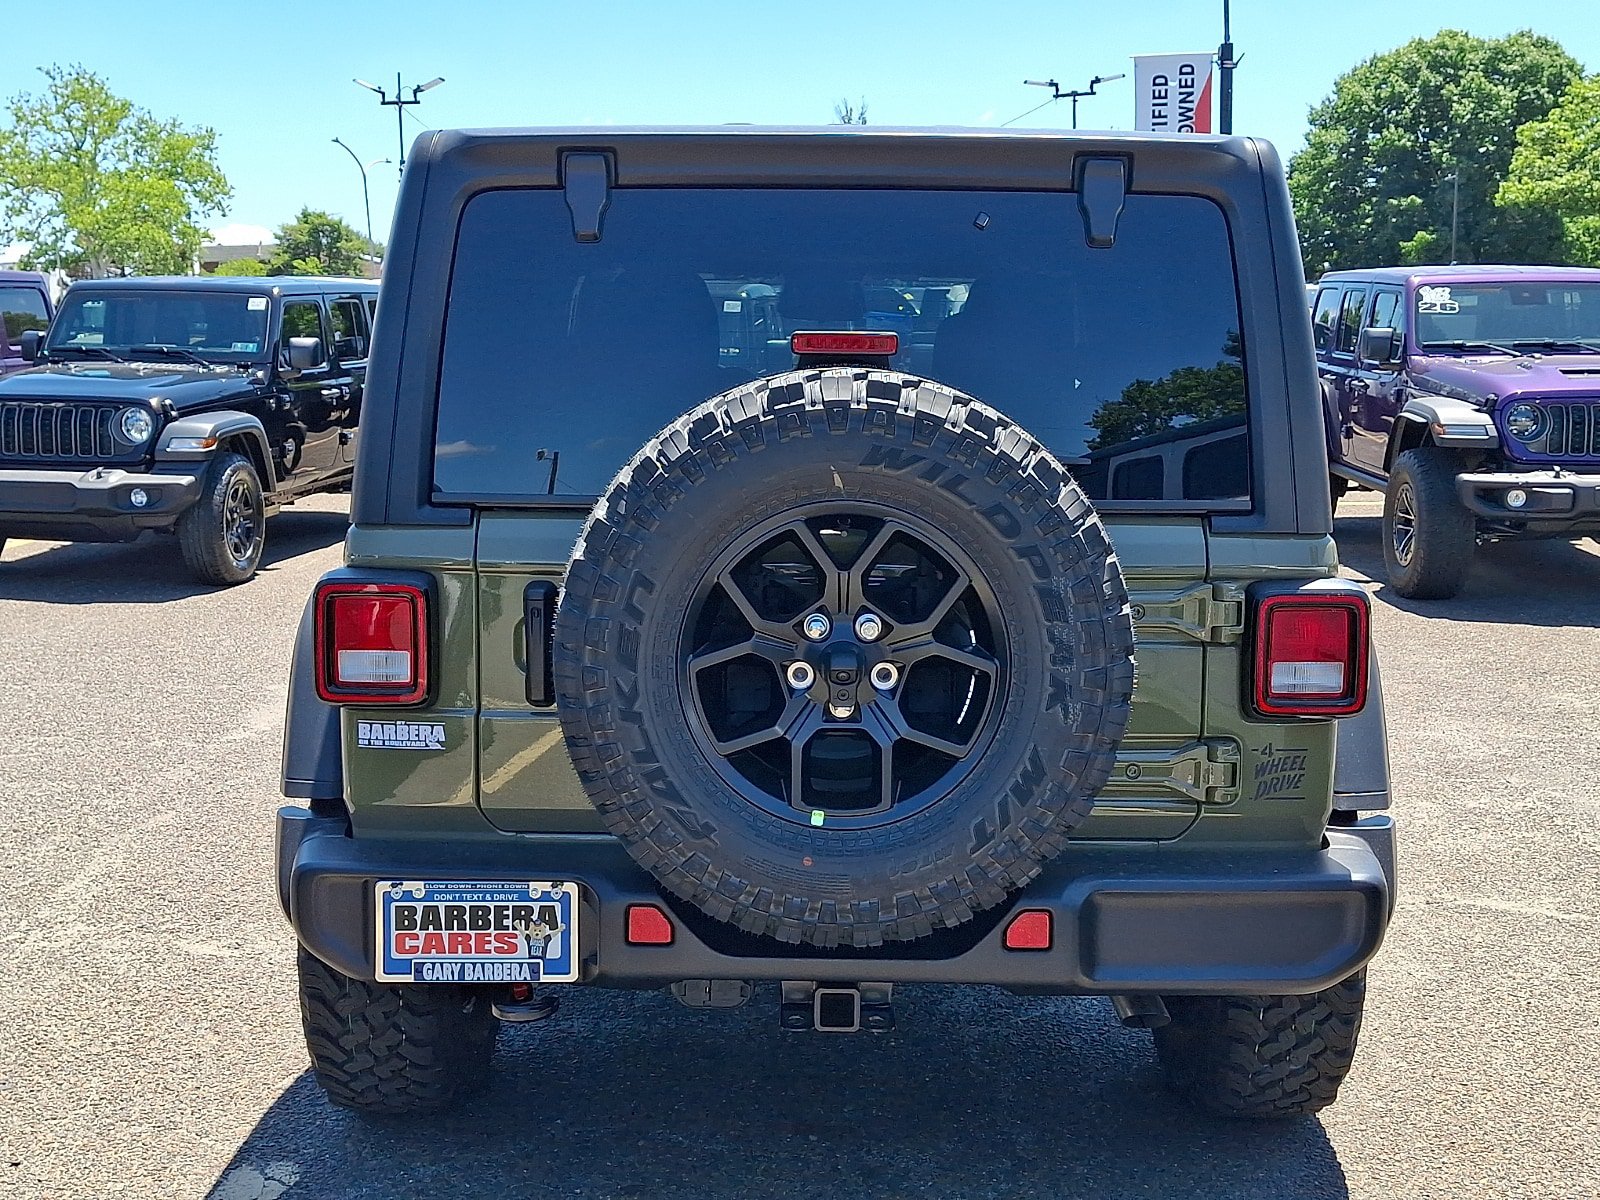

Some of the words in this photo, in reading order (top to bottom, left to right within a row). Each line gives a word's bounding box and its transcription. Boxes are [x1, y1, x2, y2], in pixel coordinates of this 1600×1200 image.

[1151, 74, 1168, 132] IFIED
[858, 443, 1078, 720] WILDPEAK
[615, 569, 719, 848] FALKEN
[358, 723, 446, 742] BARBERA
[1260, 742, 1274, 757] 4
[1254, 755, 1307, 780] WHEEL
[1254, 773, 1306, 801] DRIVE
[433, 893, 460, 901] DON'T
[462, 893, 484, 901] TEXT
[485, 893, 492, 901] &
[493, 893, 520, 901] DRIVE
[394, 904, 560, 931] BARBERA
[394, 932, 519, 955] CARES
[422, 962, 462, 981] GARY
[464, 962, 531, 981] BARBERA
